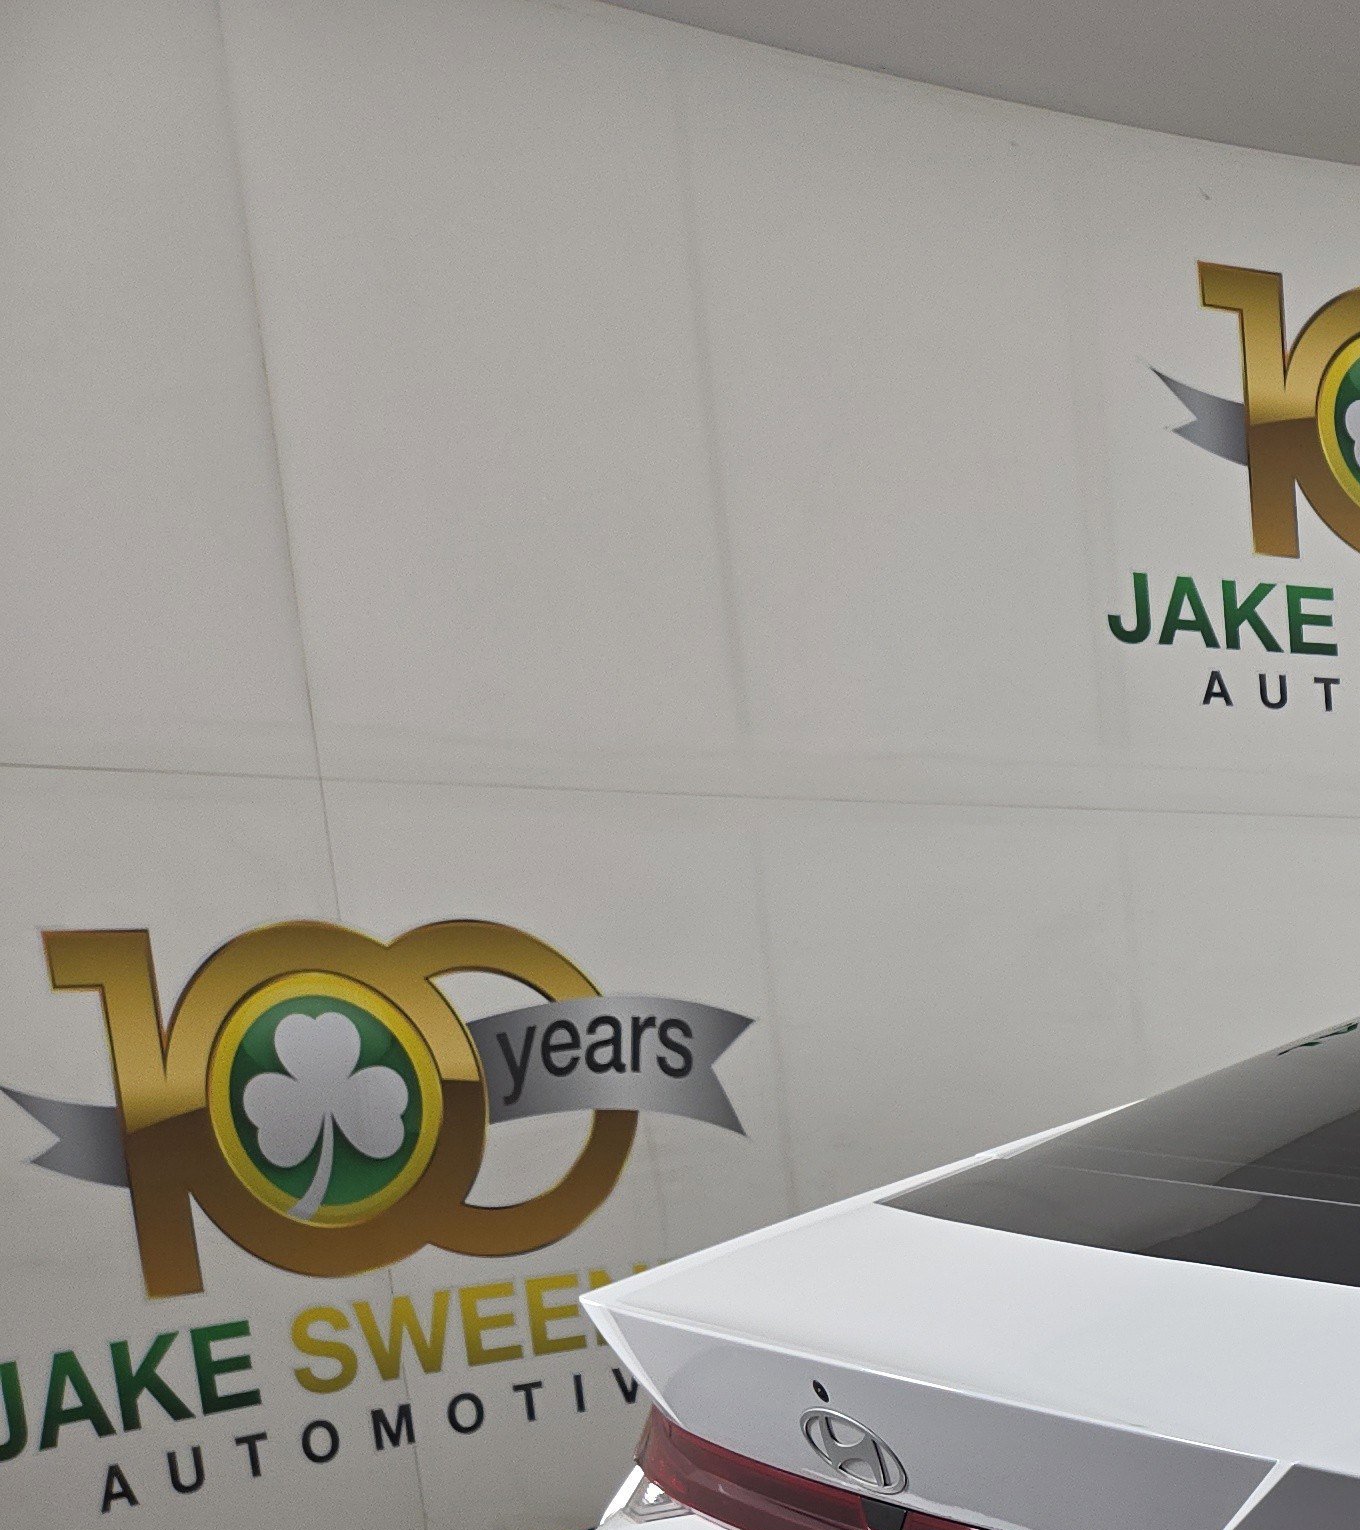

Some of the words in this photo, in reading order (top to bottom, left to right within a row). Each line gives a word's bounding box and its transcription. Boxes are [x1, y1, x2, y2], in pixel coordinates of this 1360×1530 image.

[1107, 571, 1339, 657] JAKE
[497, 1012, 694, 1105] years
[0, 1320, 262, 1463] JAKE
[290, 1260, 668, 1396] SWEE
[101, 1368, 639, 1513] AUTOMOTIV
